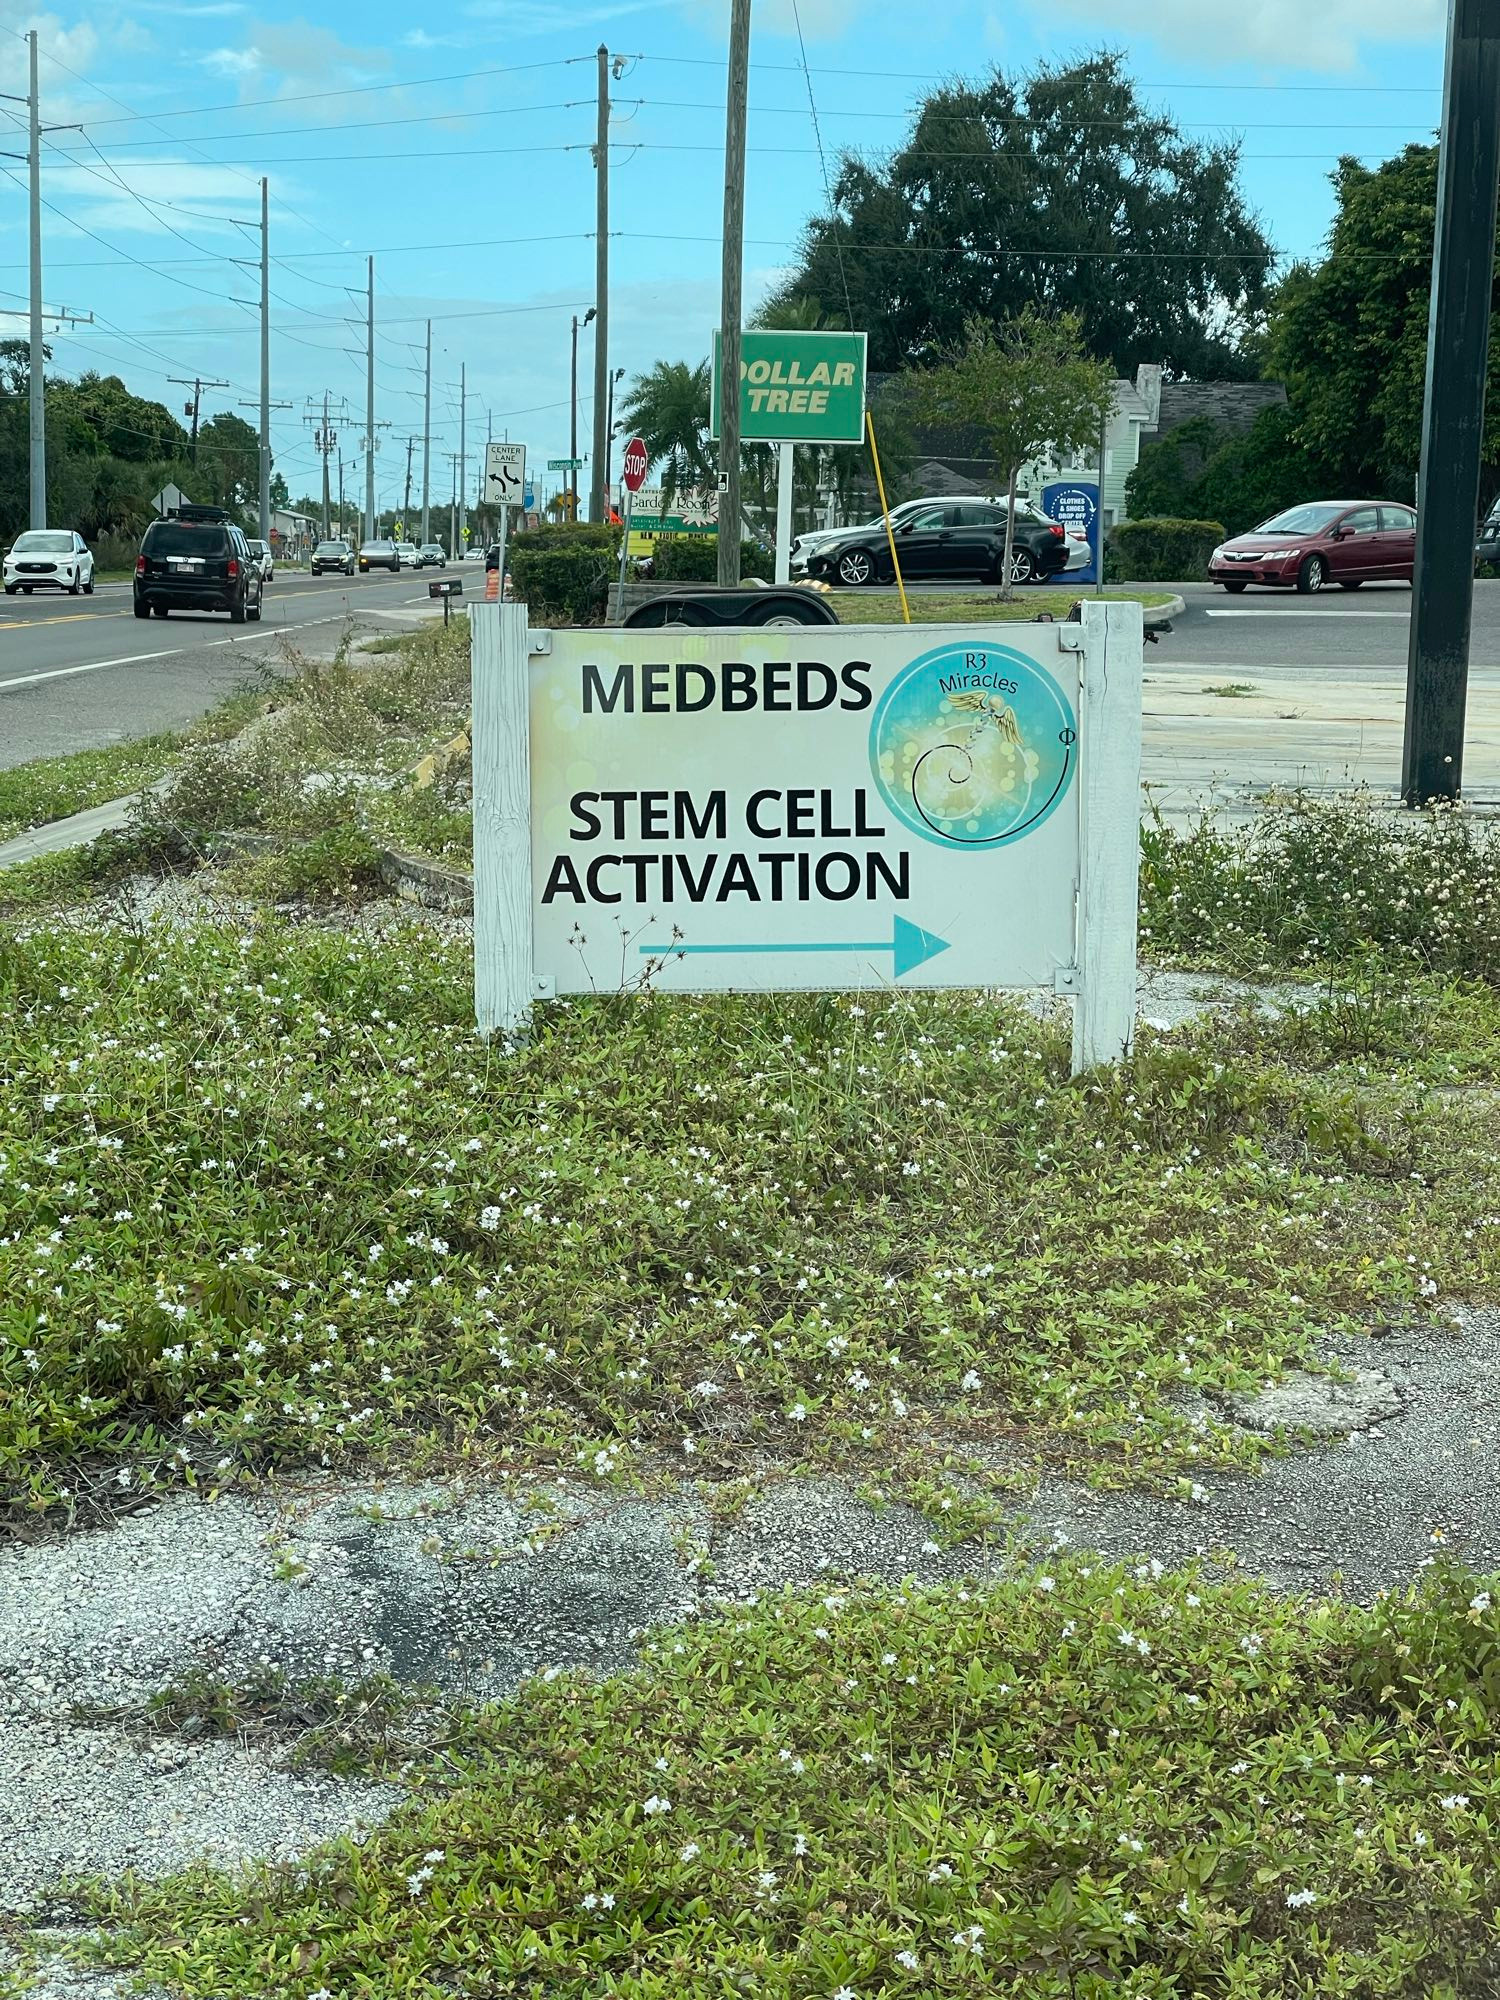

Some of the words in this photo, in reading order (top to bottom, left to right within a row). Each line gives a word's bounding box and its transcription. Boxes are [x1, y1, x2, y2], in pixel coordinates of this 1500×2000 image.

[748, 389, 830, 413] TREE
[491, 446, 521, 455] CENTER
[572, 460, 582, 469] Ave
[625, 454, 645, 476] STOP
[494, 494, 513, 502] ONLY
[677, 496, 710, 509] Room
[966, 653, 987, 671] R3
[582, 661, 873, 714] MEDBEDS
[938, 672, 1019, 695] Miracles
[569, 790, 727, 841] STEM
[745, 788, 886, 839] CELL
[541, 851, 910, 904] ACTIVATION
